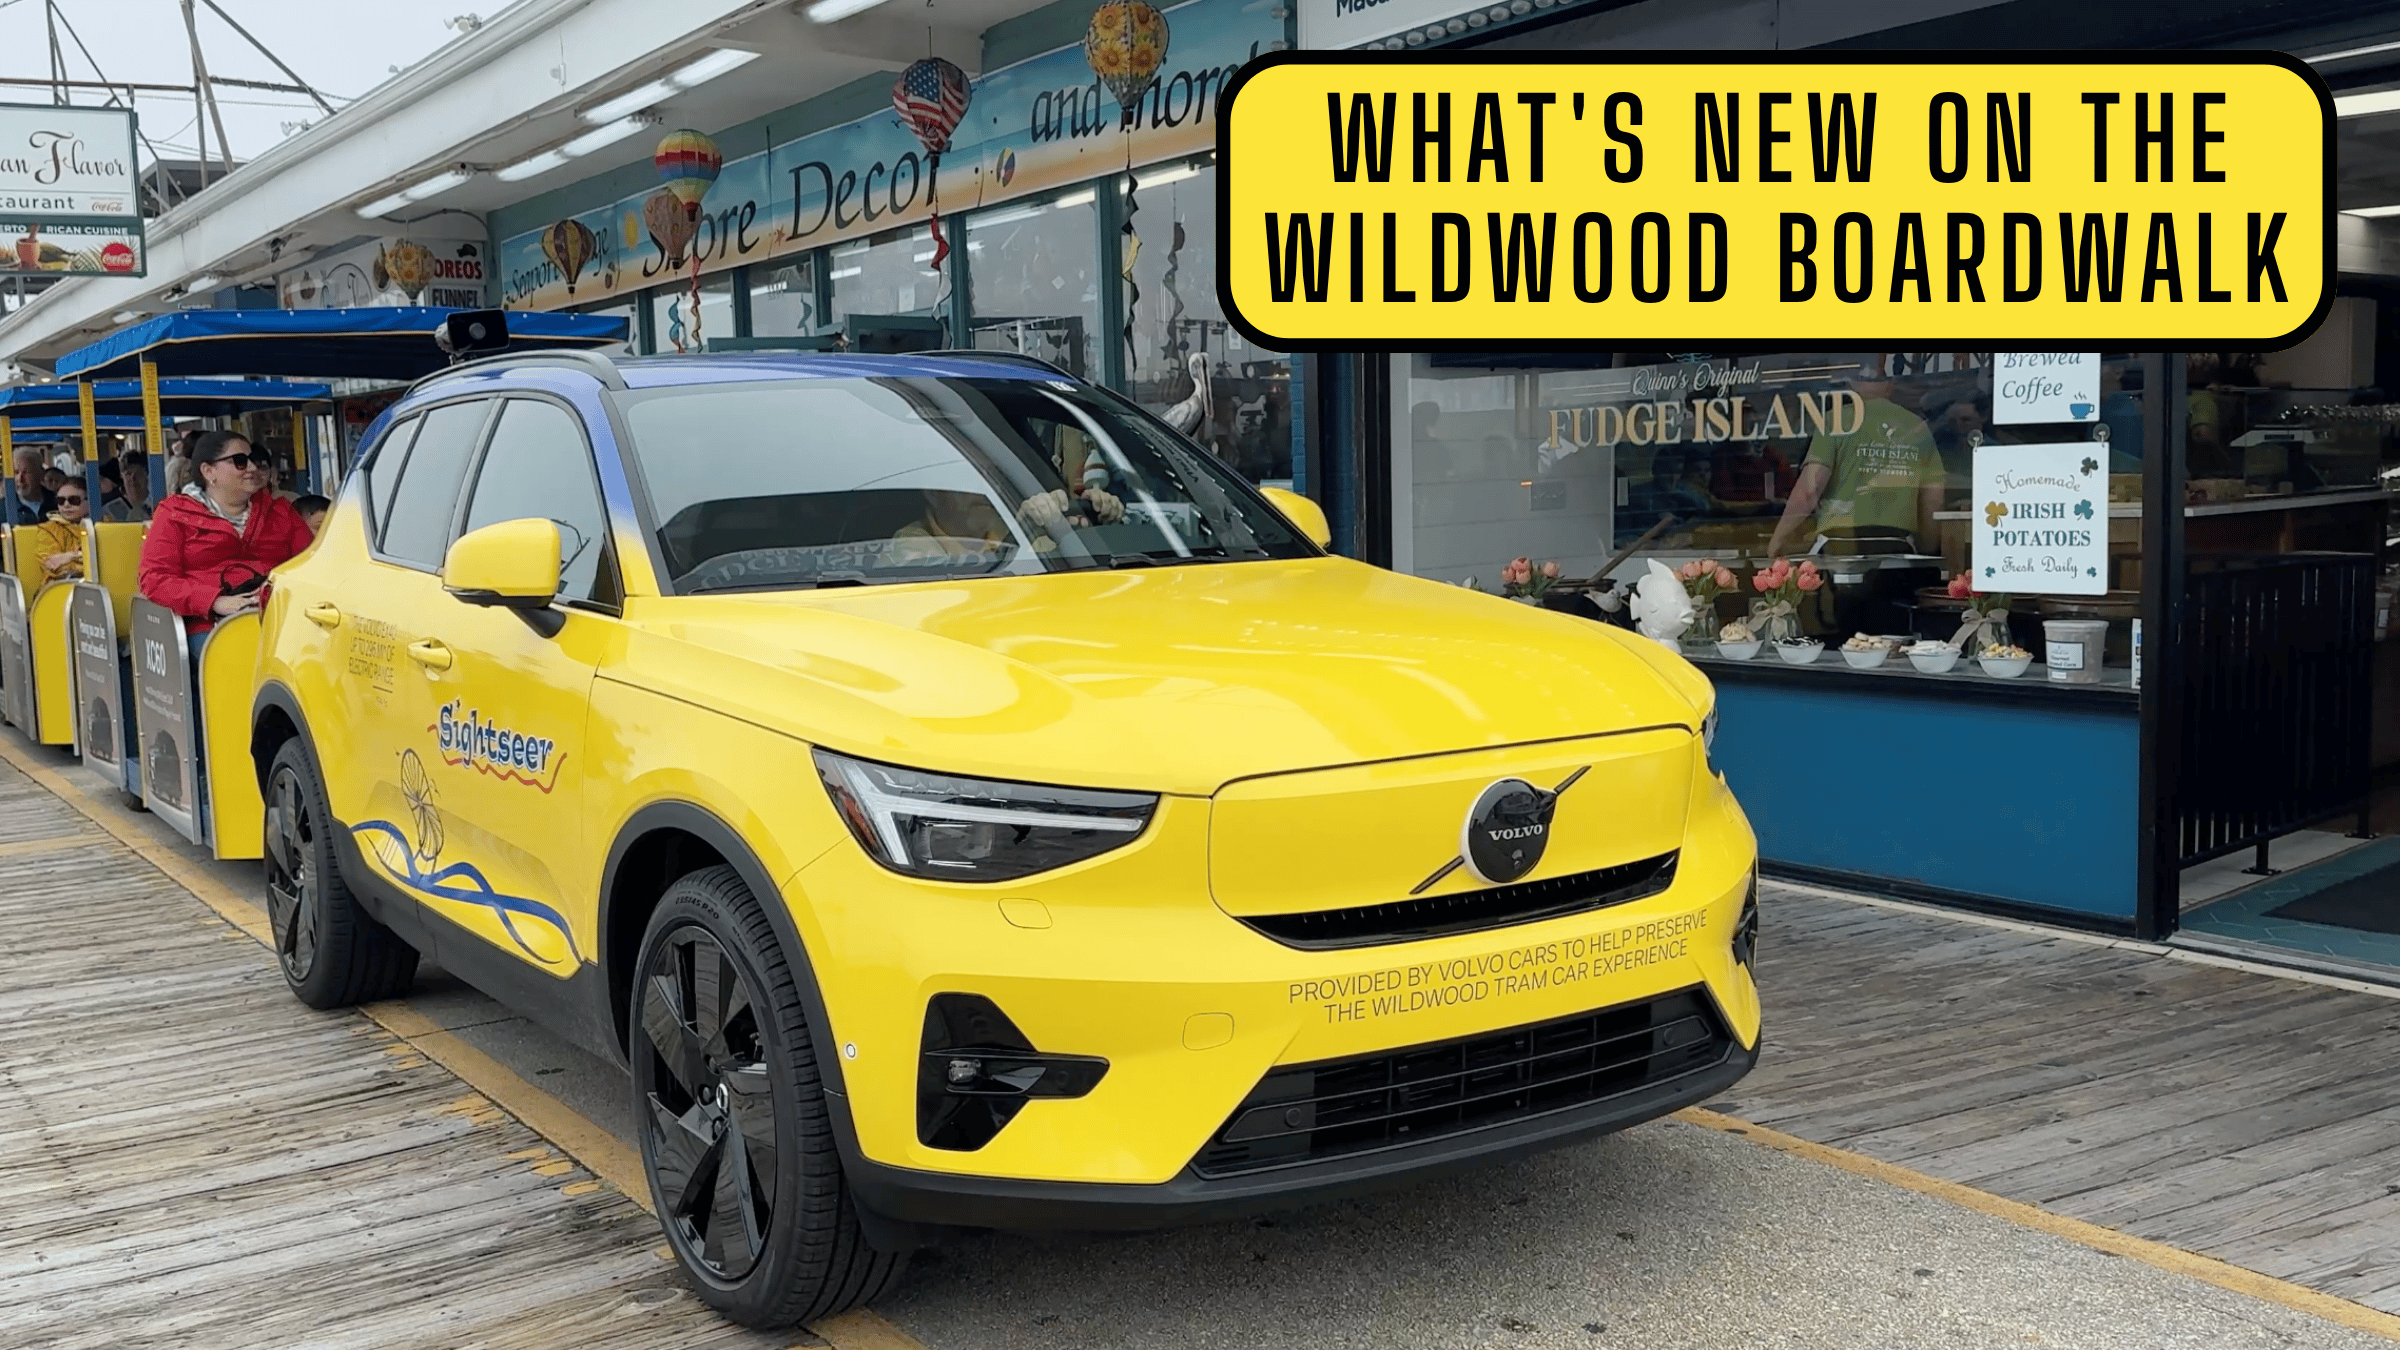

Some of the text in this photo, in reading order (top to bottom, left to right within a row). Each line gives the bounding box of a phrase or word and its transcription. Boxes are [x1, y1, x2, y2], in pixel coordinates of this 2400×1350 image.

[1030, 75, 1108, 143] and
[29, 131, 127, 184] Flavor
[46, 225, 128, 235] RICAN CUISINE
[643, 200, 760, 277] Sore
[434, 259, 482, 279] OREOS
[432, 288, 482, 308] FUNNEL
[2003, 353, 2083, 368] Brewed
[1633, 361, 1760, 397] Quinn's Original
[2002, 377, 2063, 404] Coffee
[1549, 390, 1865, 449] FUDGE ISLAND
[1995, 469, 2081, 494] Homemade
[2012, 502, 2066, 519] IRISH
[1993, 530, 2091, 547] POTATOES
[2001, 555, 2078, 579] Fresh Daily
[145, 638, 167, 677] XC60
[440, 698, 554, 772] Sightseer
[1488, 824, 1543, 841] VOLVO
[1289, 908, 1708, 1004] PROVIDED BY VOLVO CARS TO HELP PRESERVE
[1324, 938, 1689, 1024] THE WILDWOOD TRAM CAR EXPERIENCE
